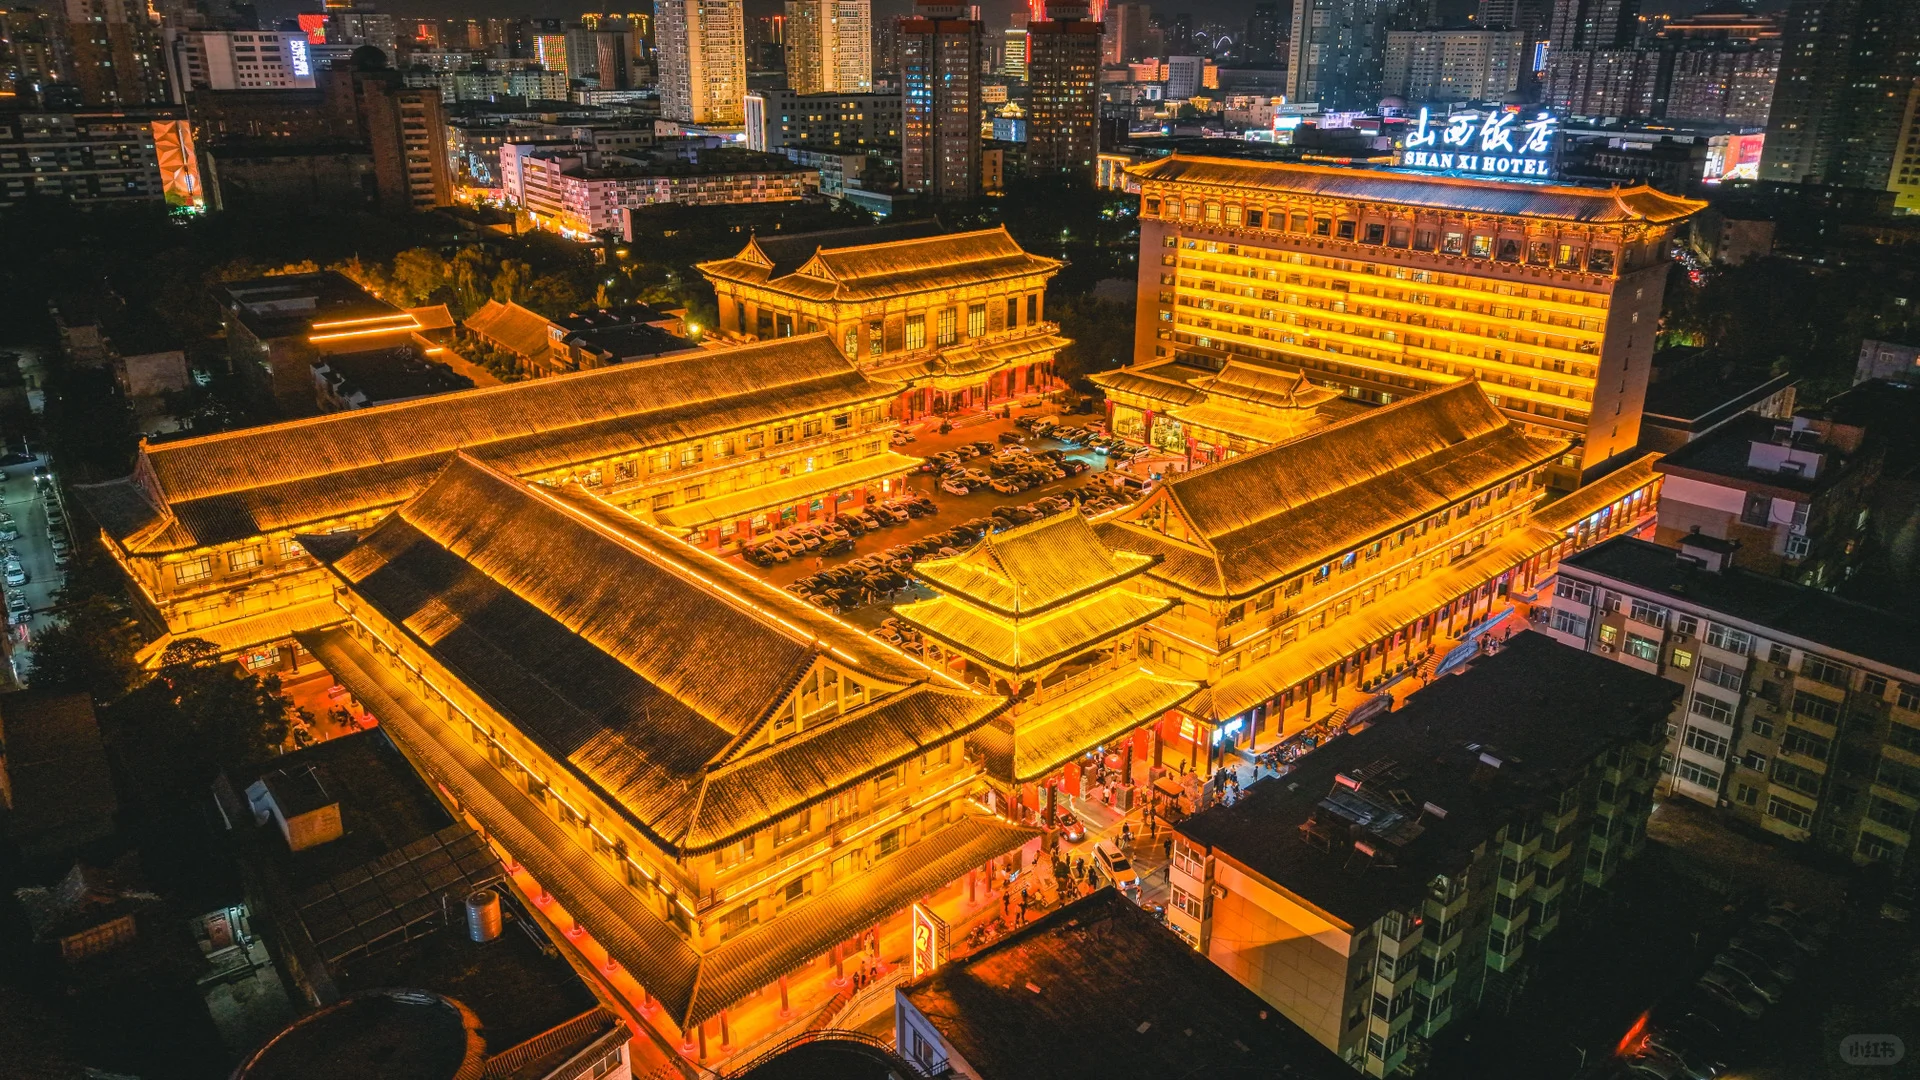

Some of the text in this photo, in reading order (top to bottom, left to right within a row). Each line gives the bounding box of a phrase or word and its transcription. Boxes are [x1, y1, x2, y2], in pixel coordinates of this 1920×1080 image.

[1405, 107, 1557, 154] 山西饭店
[1405, 152, 1548, 175] SHAN XI HOTEL
